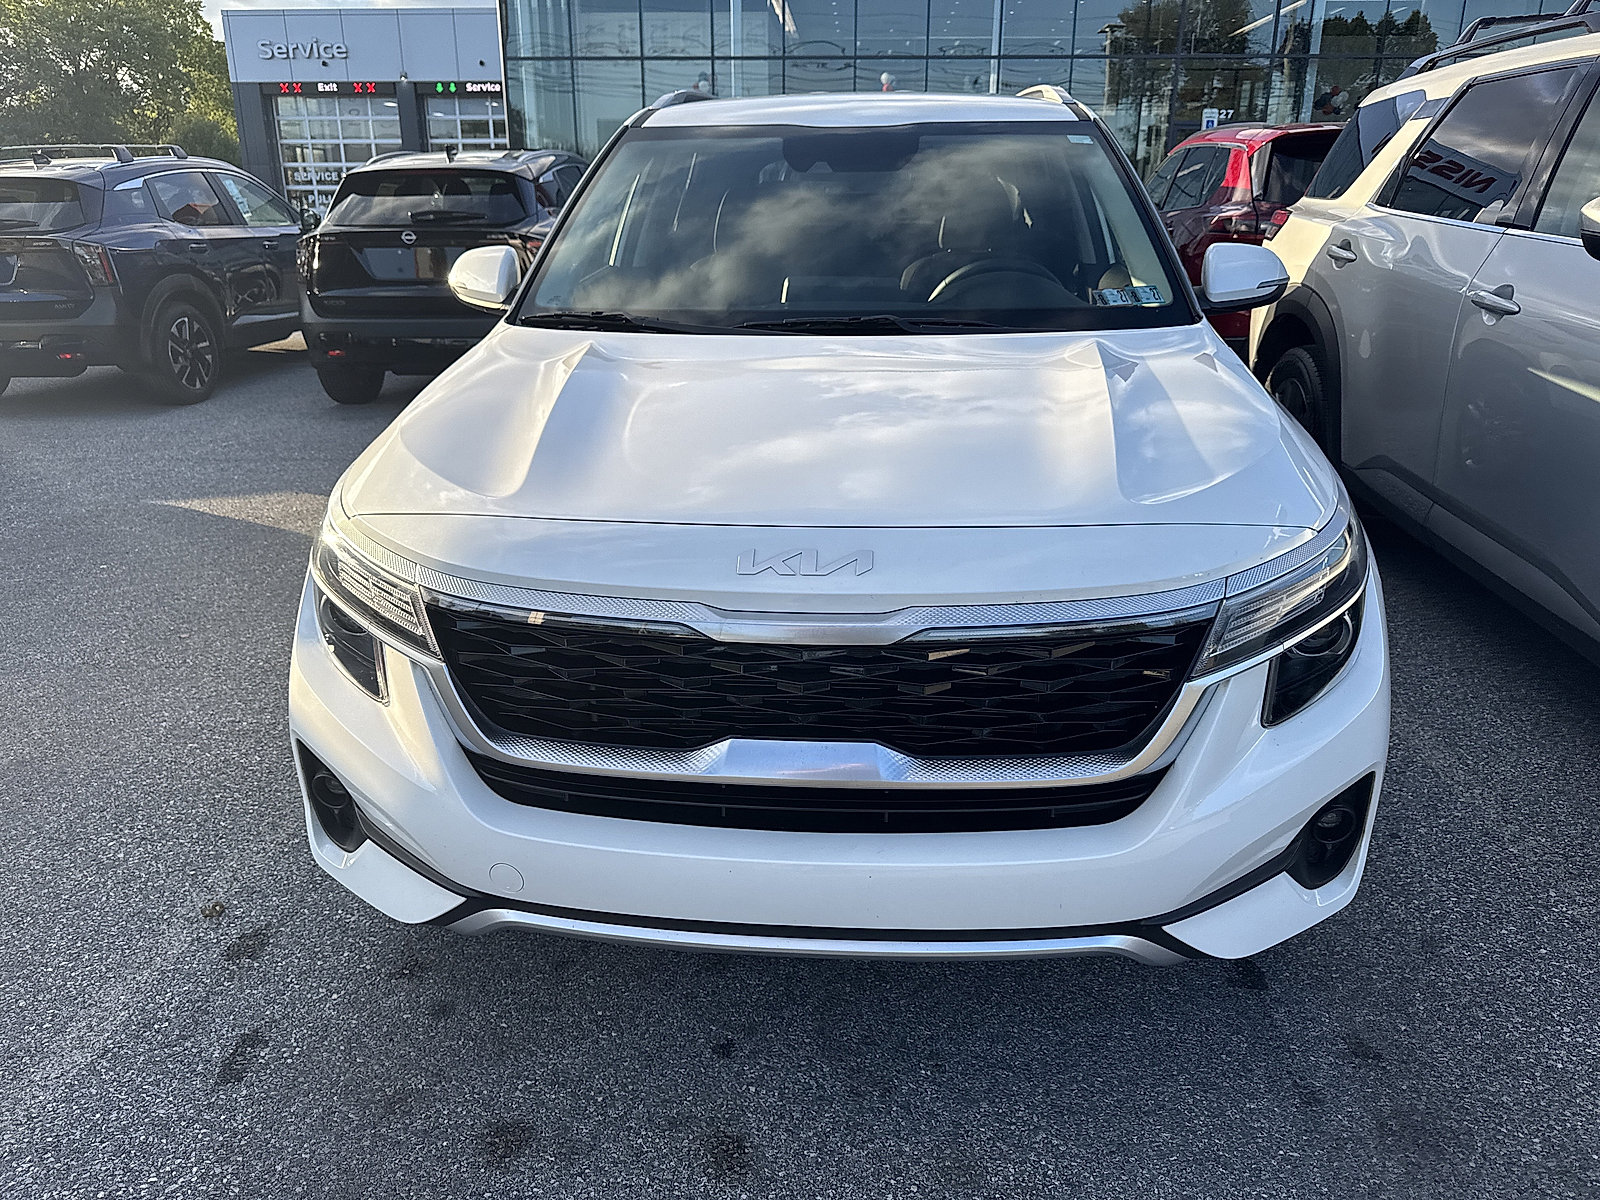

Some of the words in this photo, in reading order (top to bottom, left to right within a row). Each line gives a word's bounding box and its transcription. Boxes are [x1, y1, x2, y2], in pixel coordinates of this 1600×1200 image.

[257, 37, 348, 60] Service
[317, 82, 338, 92] Exit
[465, 82, 501, 92] Service
[1219, 109, 1234, 119] 27
[1116, 289, 1129, 302] 27
[1149, 287, 1162, 300] 27
[736, 549, 874, 577] KIA
